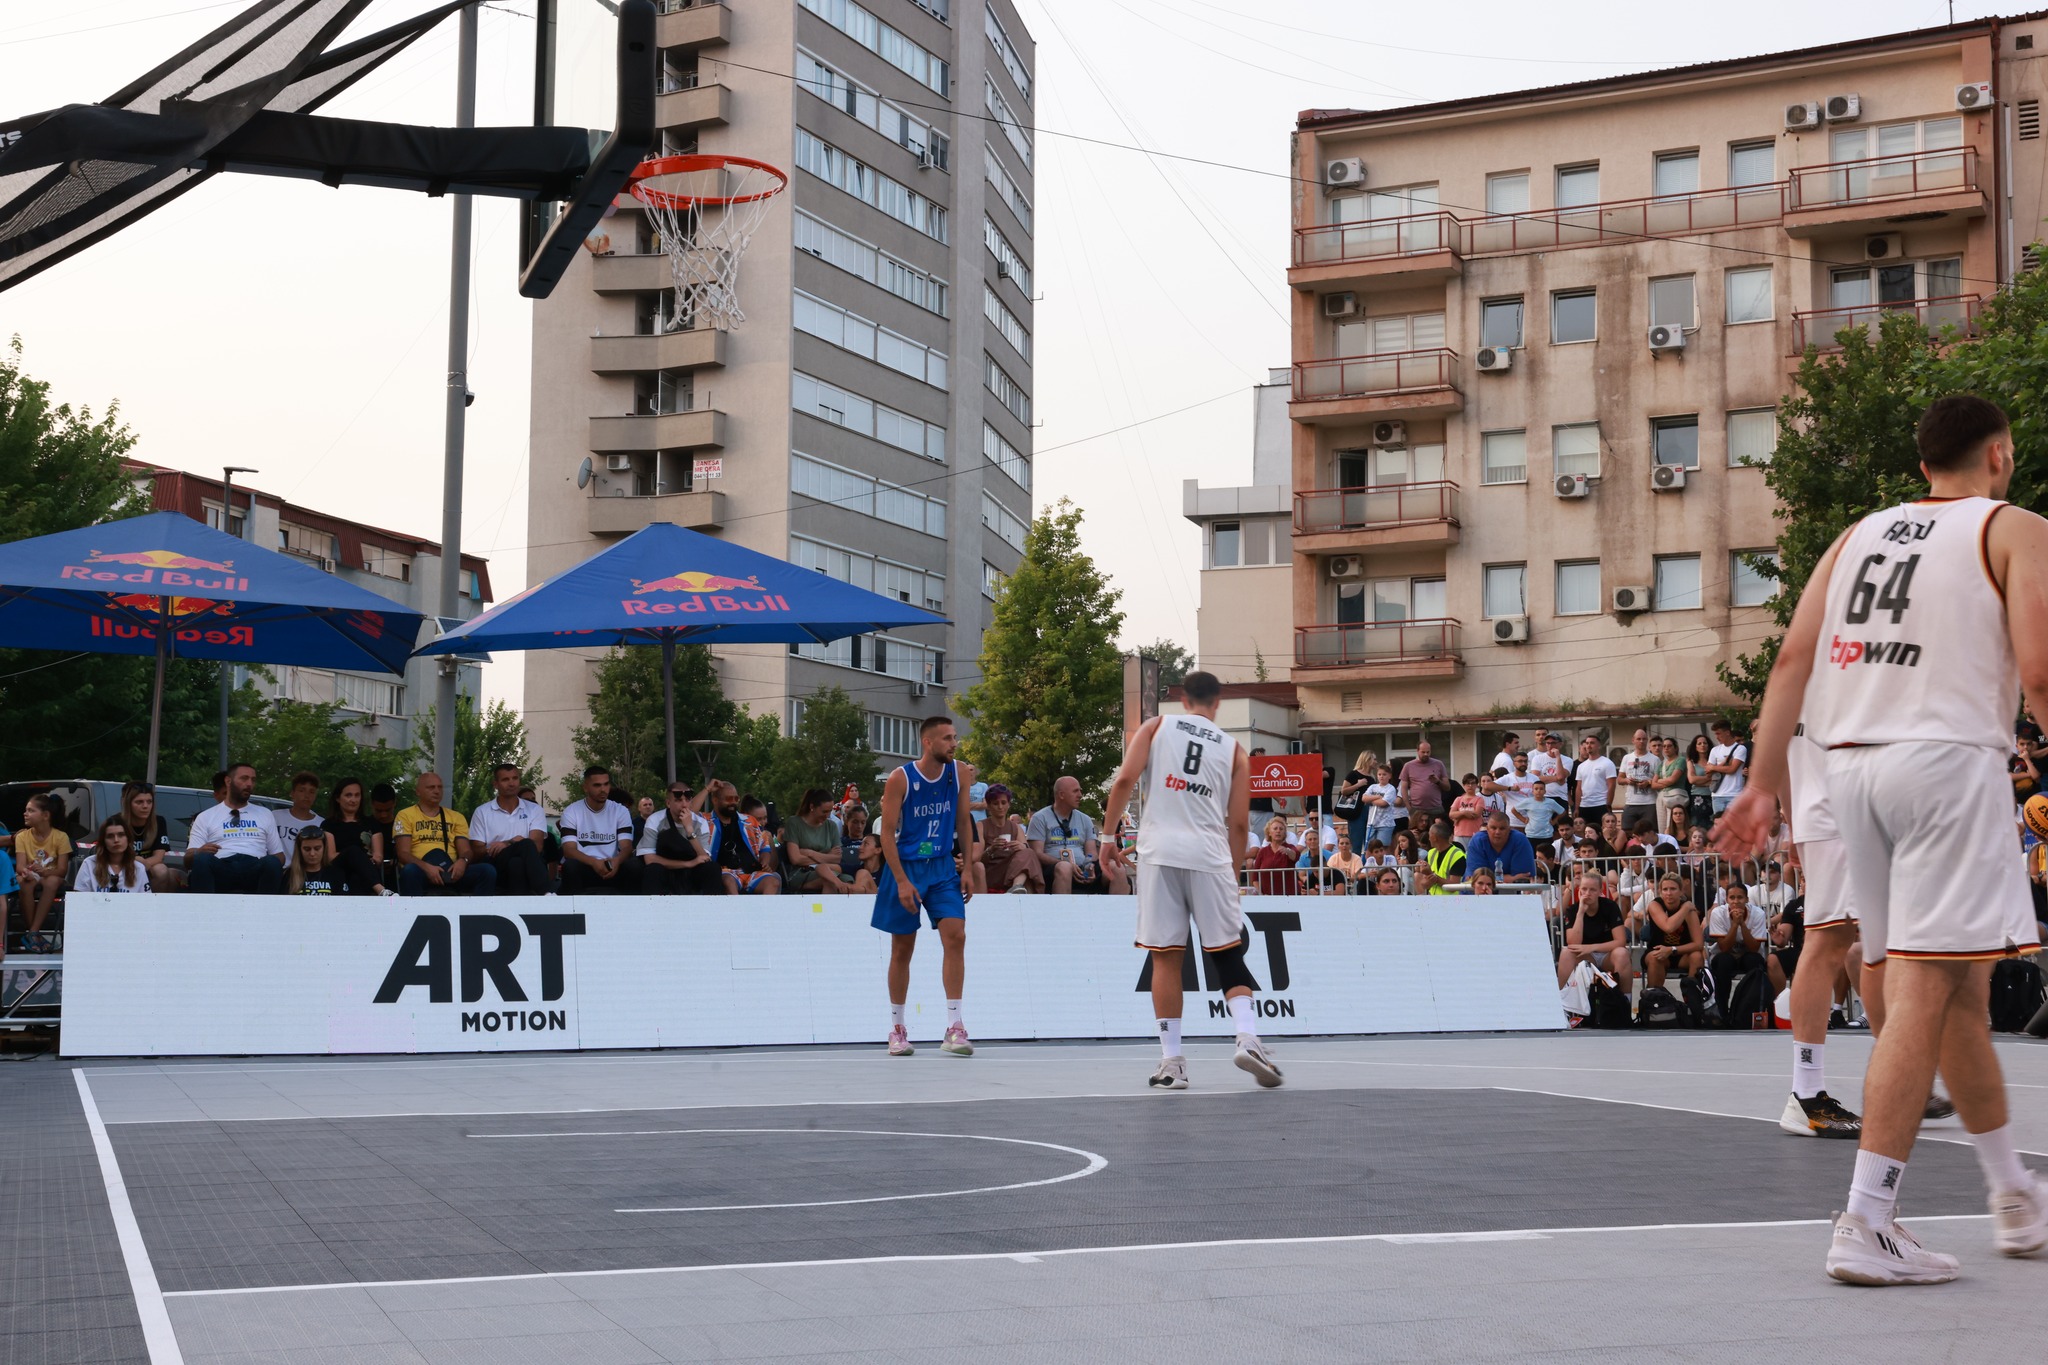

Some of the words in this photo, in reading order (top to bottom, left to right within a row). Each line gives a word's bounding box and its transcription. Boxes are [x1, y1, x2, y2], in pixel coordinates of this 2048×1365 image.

[61, 565, 154, 585] Red
[161, 571, 248, 591] Bull
[1846, 553, 1921, 625] 64
[622, 595, 707, 615] Red
[709, 595, 790, 611] Bull
[1830, 635, 1922, 670] tipwin
[1183, 740, 1203, 775] 8
[1165, 773, 1212, 798] tipwin
[1253, 778, 1299, 788] vitaminka
[914, 801, 951, 817] KOSOVA
[927, 820, 940, 838] 12
[372, 914, 587, 1003] ART
[1208, 1000, 1295, 1018] MION
[462, 1010, 566, 1032] MOTION
